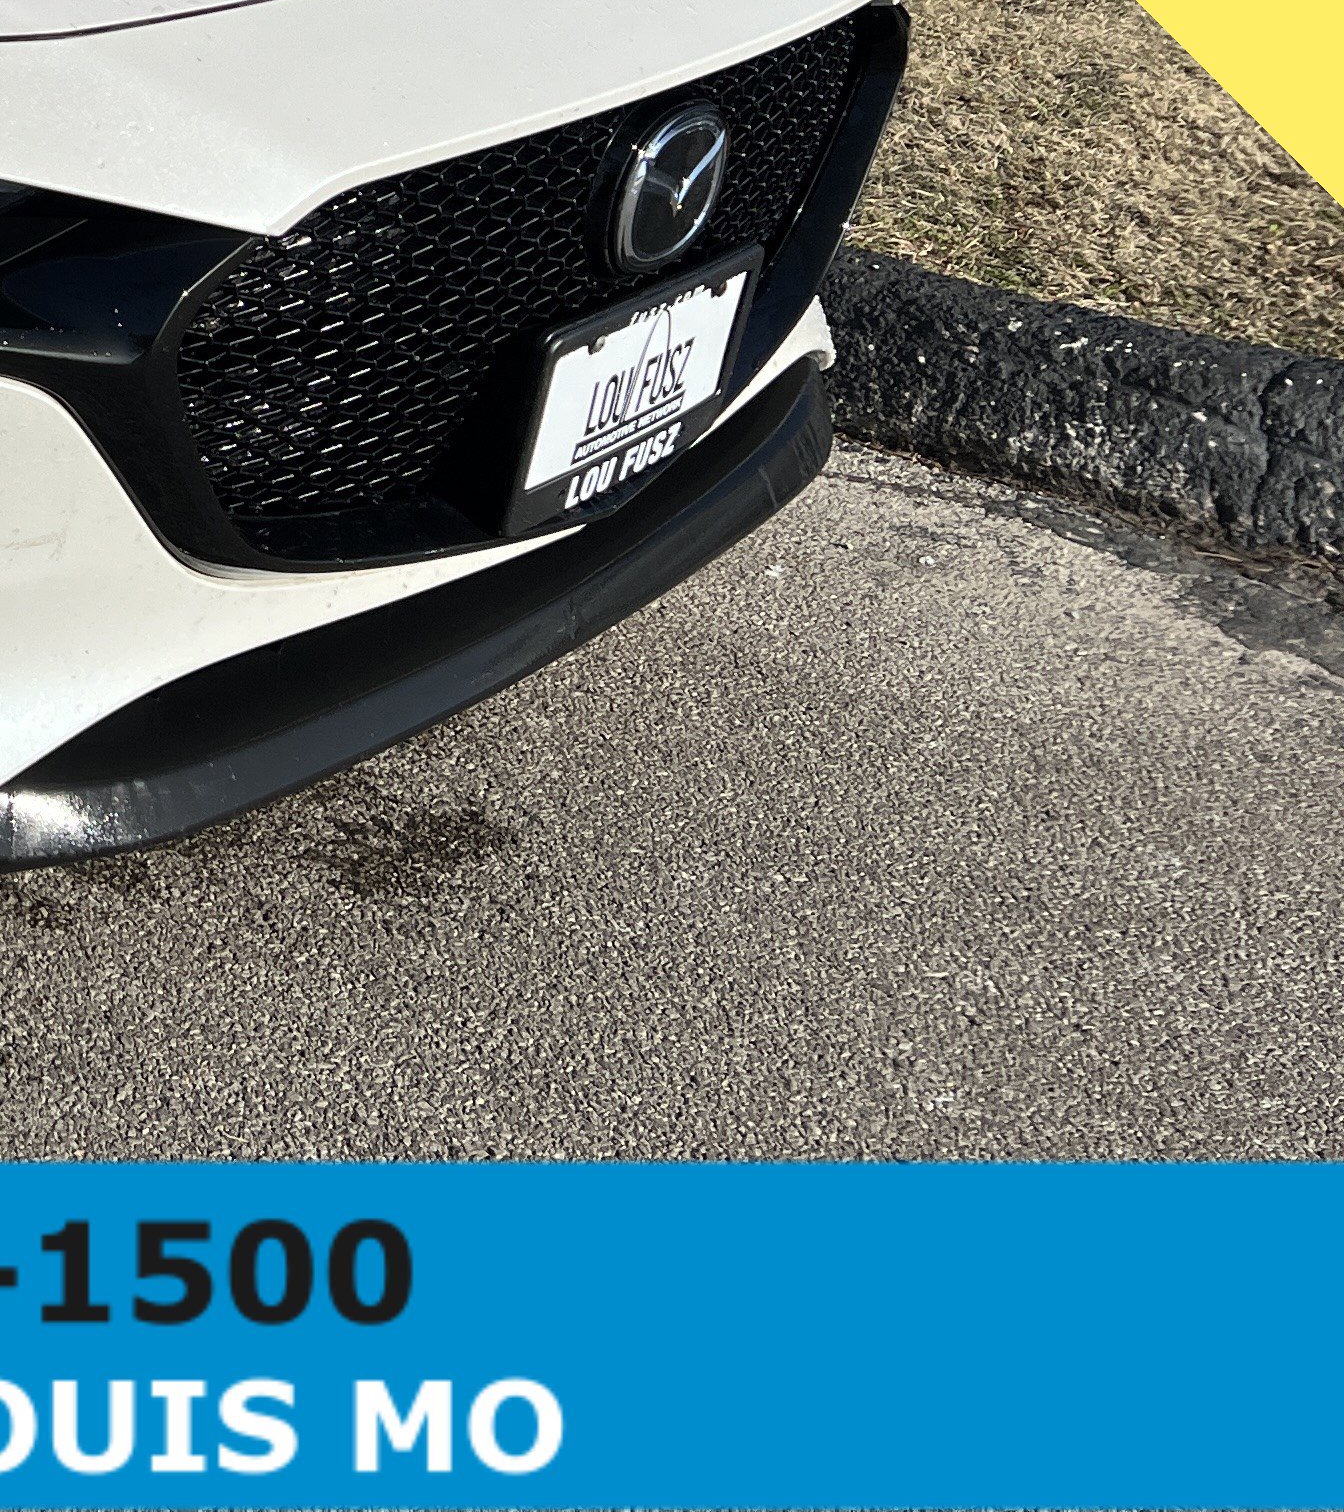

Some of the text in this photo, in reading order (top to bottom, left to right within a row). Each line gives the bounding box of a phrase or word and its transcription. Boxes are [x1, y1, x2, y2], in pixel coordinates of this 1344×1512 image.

[574, 397, 683, 460] AUTOMOTIVE NETWORK
[584, 337, 696, 437] LOU FUSZ
[565, 421, 683, 509] LOU FUSZ
